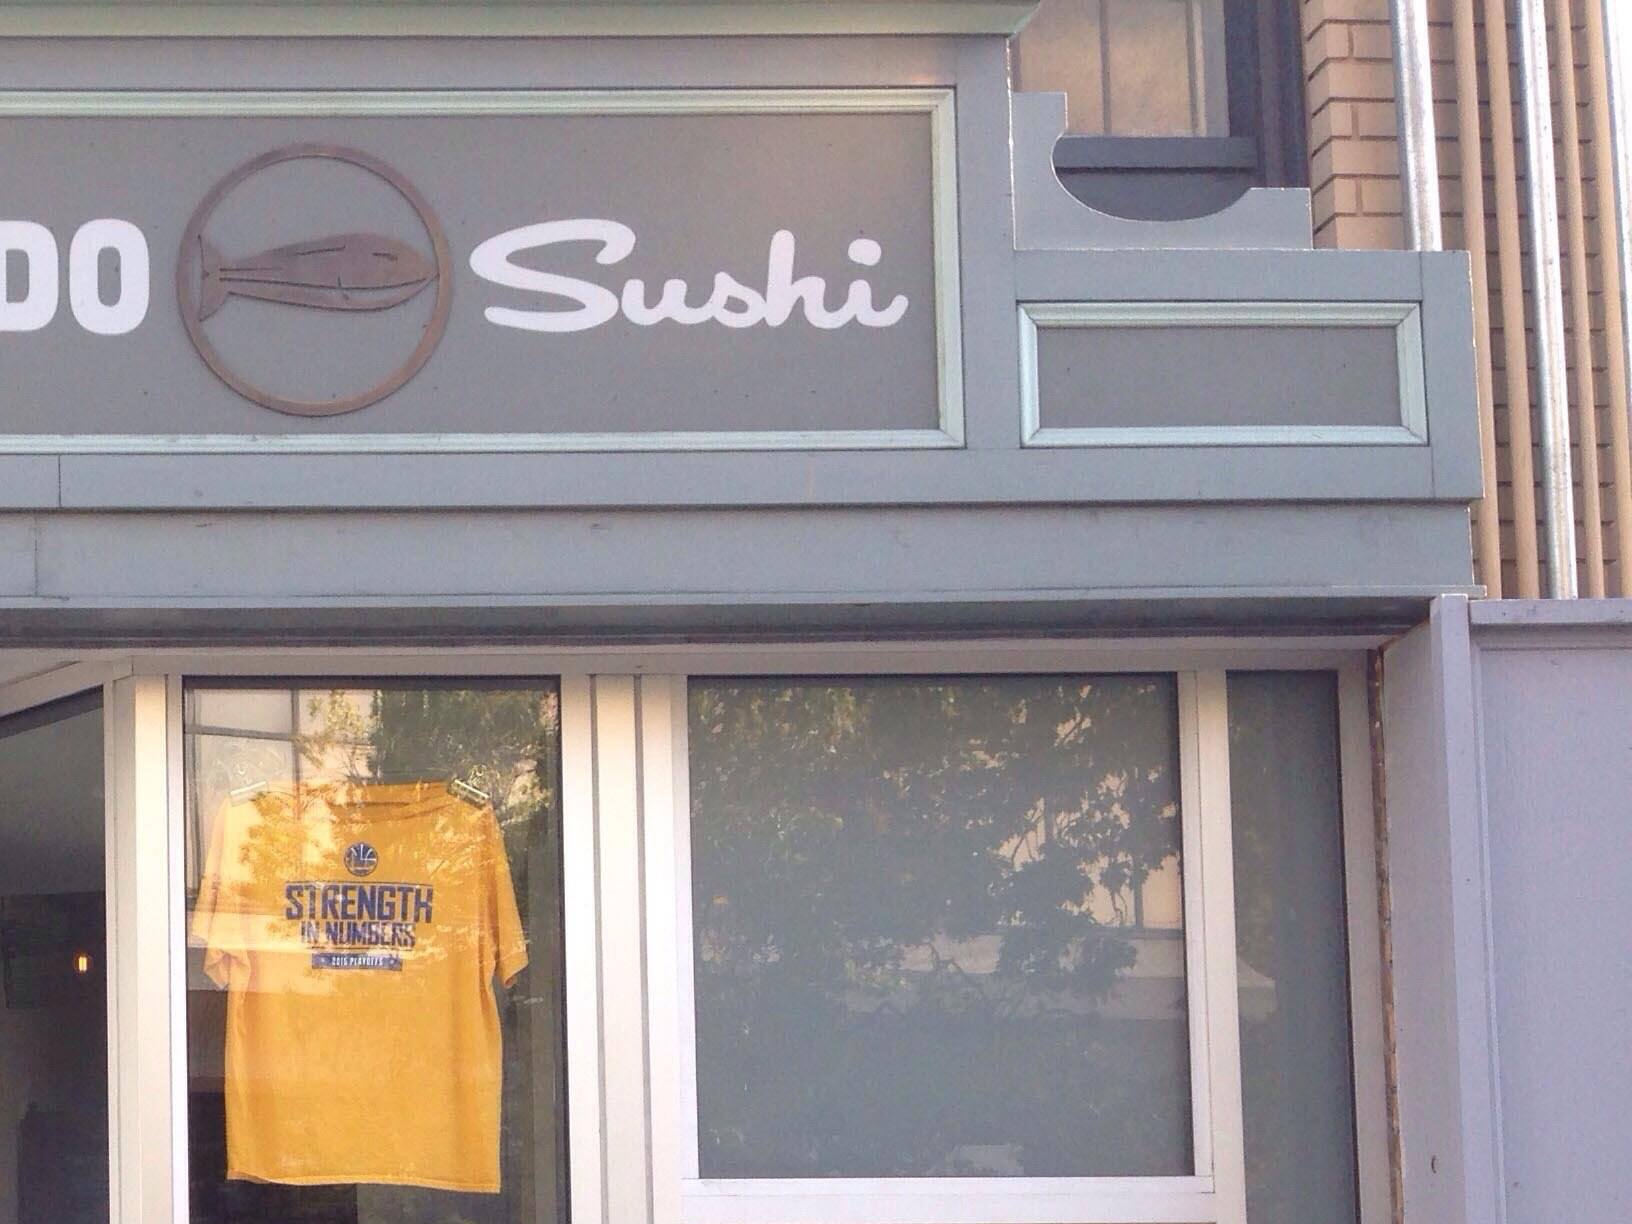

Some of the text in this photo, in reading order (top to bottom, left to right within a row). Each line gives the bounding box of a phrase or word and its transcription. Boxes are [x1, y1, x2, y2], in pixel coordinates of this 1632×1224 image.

[469, 217, 908, 332] Sushi
[285, 884, 434, 923] STRENGTH
[324, 921, 417, 948] NUMBERS
